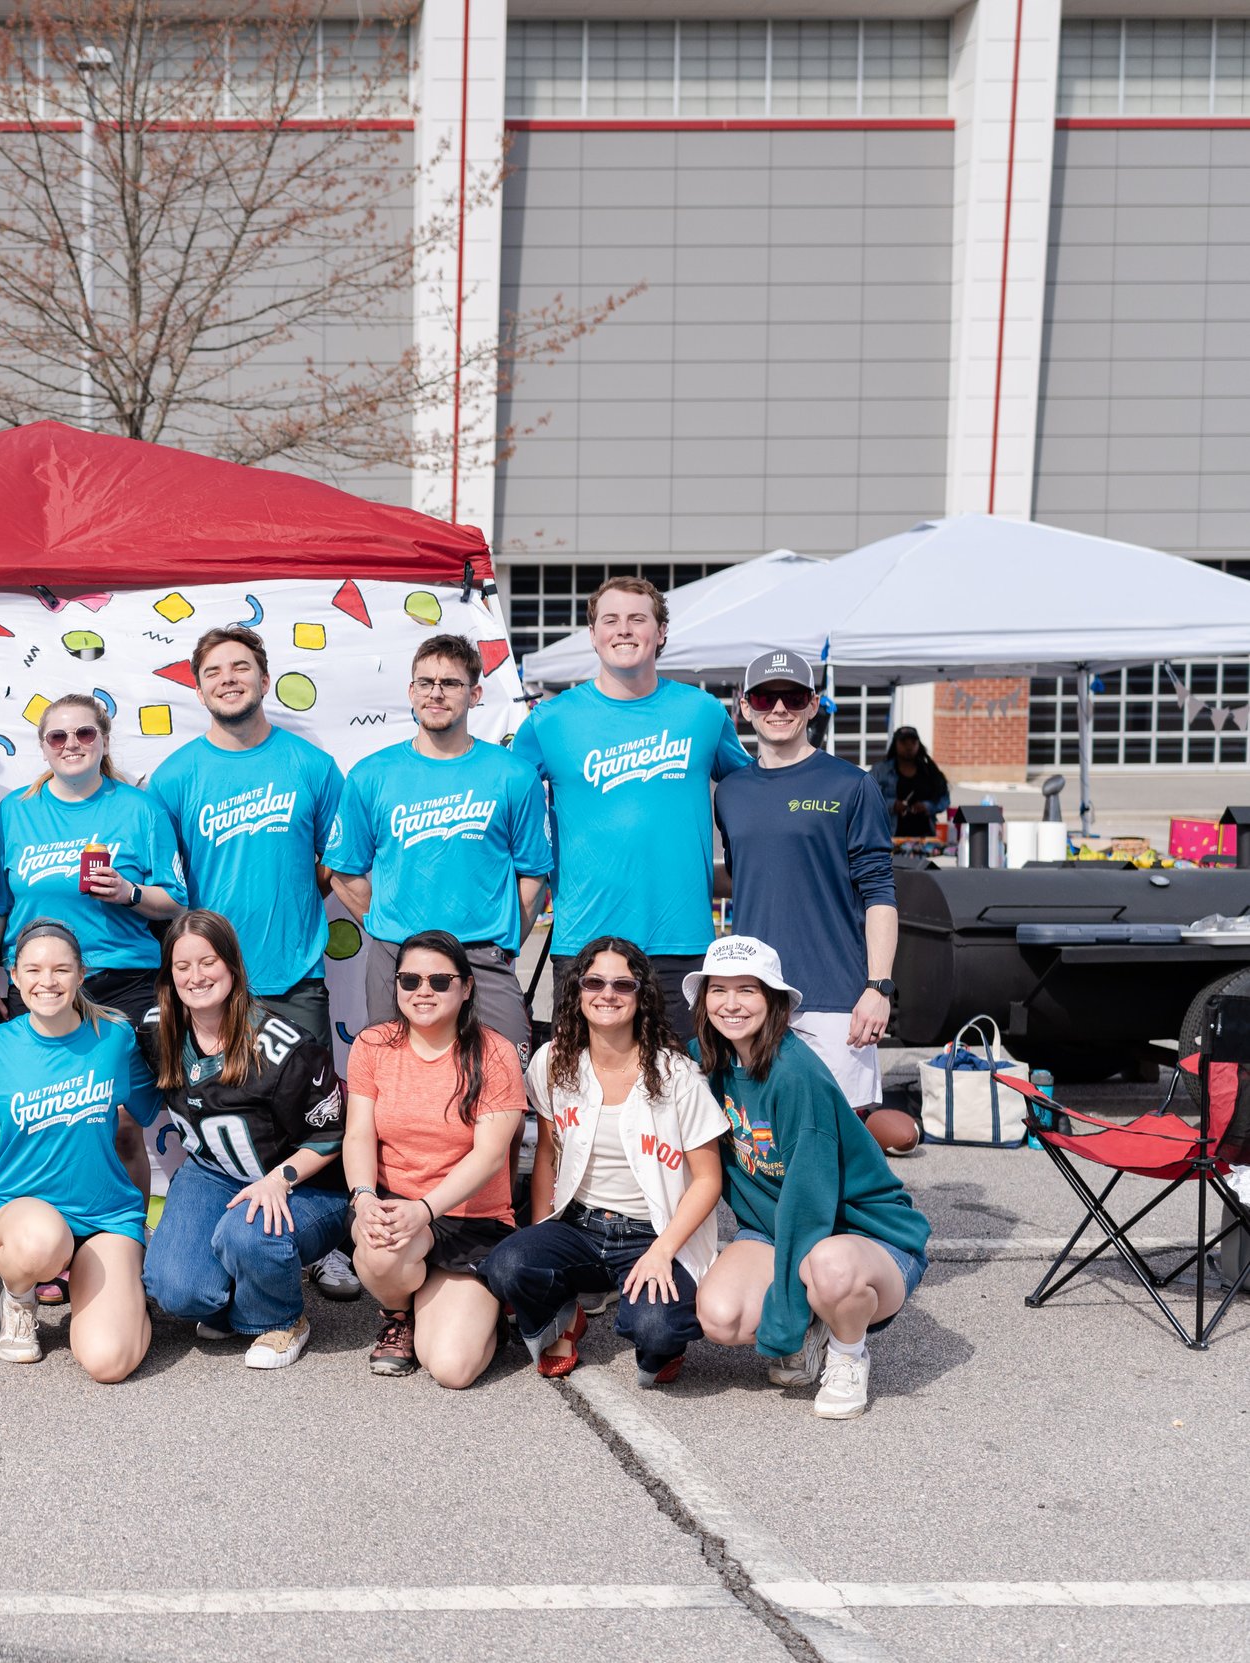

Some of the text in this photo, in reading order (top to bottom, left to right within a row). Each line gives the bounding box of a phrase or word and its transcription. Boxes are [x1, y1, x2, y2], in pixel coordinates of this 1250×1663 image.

[583, 729, 692, 788] Gameday
[605, 734, 658, 758] ULTIMATE
[199, 782, 297, 841] Gameday
[217, 787, 264, 812] ULTIMATE
[409, 793, 463, 814] ULTIMATE
[801, 799, 841, 813] GILLZ
[390, 789, 497, 842] Gameday
[36, 837, 89, 853] ULTIMATE
[253, 1017, 301, 1066] 20
[10, 1069, 115, 1132] Gameday
[27, 1075, 85, 1102] ULTIMATE
